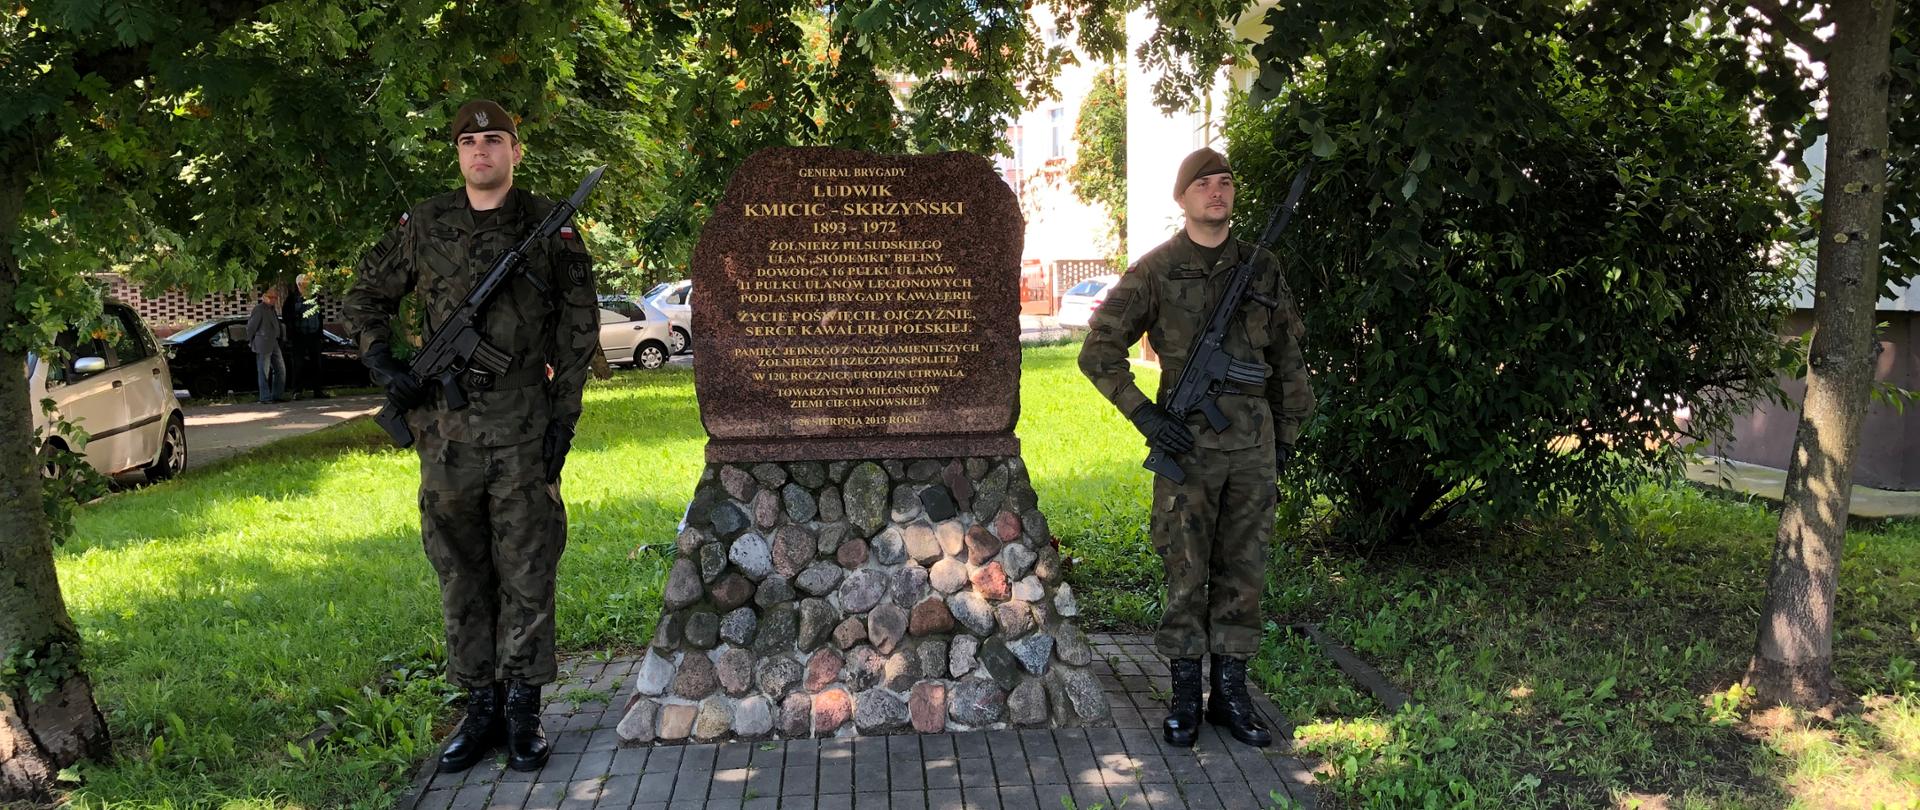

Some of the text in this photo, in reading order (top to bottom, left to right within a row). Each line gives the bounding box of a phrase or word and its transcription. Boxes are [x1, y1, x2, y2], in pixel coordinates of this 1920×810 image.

[854, 167, 907, 177] BRYGADY
[813, 184, 893, 197] LUDWIK
[744, 203, 826, 217] KMICIC
[843, 199, 963, 216] SKRZYŃSKI
[813, 221, 847, 234] 1893
[863, 221, 897, 233] 1972
[894, 253, 944, 262] BELINY
[757, 265, 829, 277] DOWÓDCA
[832, 267, 845, 276] 16
[740, 281, 751, 290] 11
[868, 278, 972, 289] LEGIONOWYCH
[740, 293, 825, 303] PODLASKIEJ
[828, 292, 894, 302] BRYGADY
[738, 310, 788, 322] ŻYCIE
[745, 323, 972, 336] SERCE KAWALERII POLSKIEJ.
[783, 346, 840, 356] JEDNEGO
[841, 346, 849, 355] Z
[852, 344, 980, 354] NAJZNAMIENITSZYCH
[830, 358, 838, 366] II
[841, 355, 958, 366] RZECZYPOSPOLITEJ
[754, 372, 765, 381] W
[853, 370, 906, 379] URODZIN
[777, 387, 864, 397] TOWARZYSTWO
[790, 399, 823, 409] ZIEMI
[811, 417, 863, 426] SIERPNIA
[865, 416, 886, 425] 2013
[889, 415, 920, 424] ROKU
